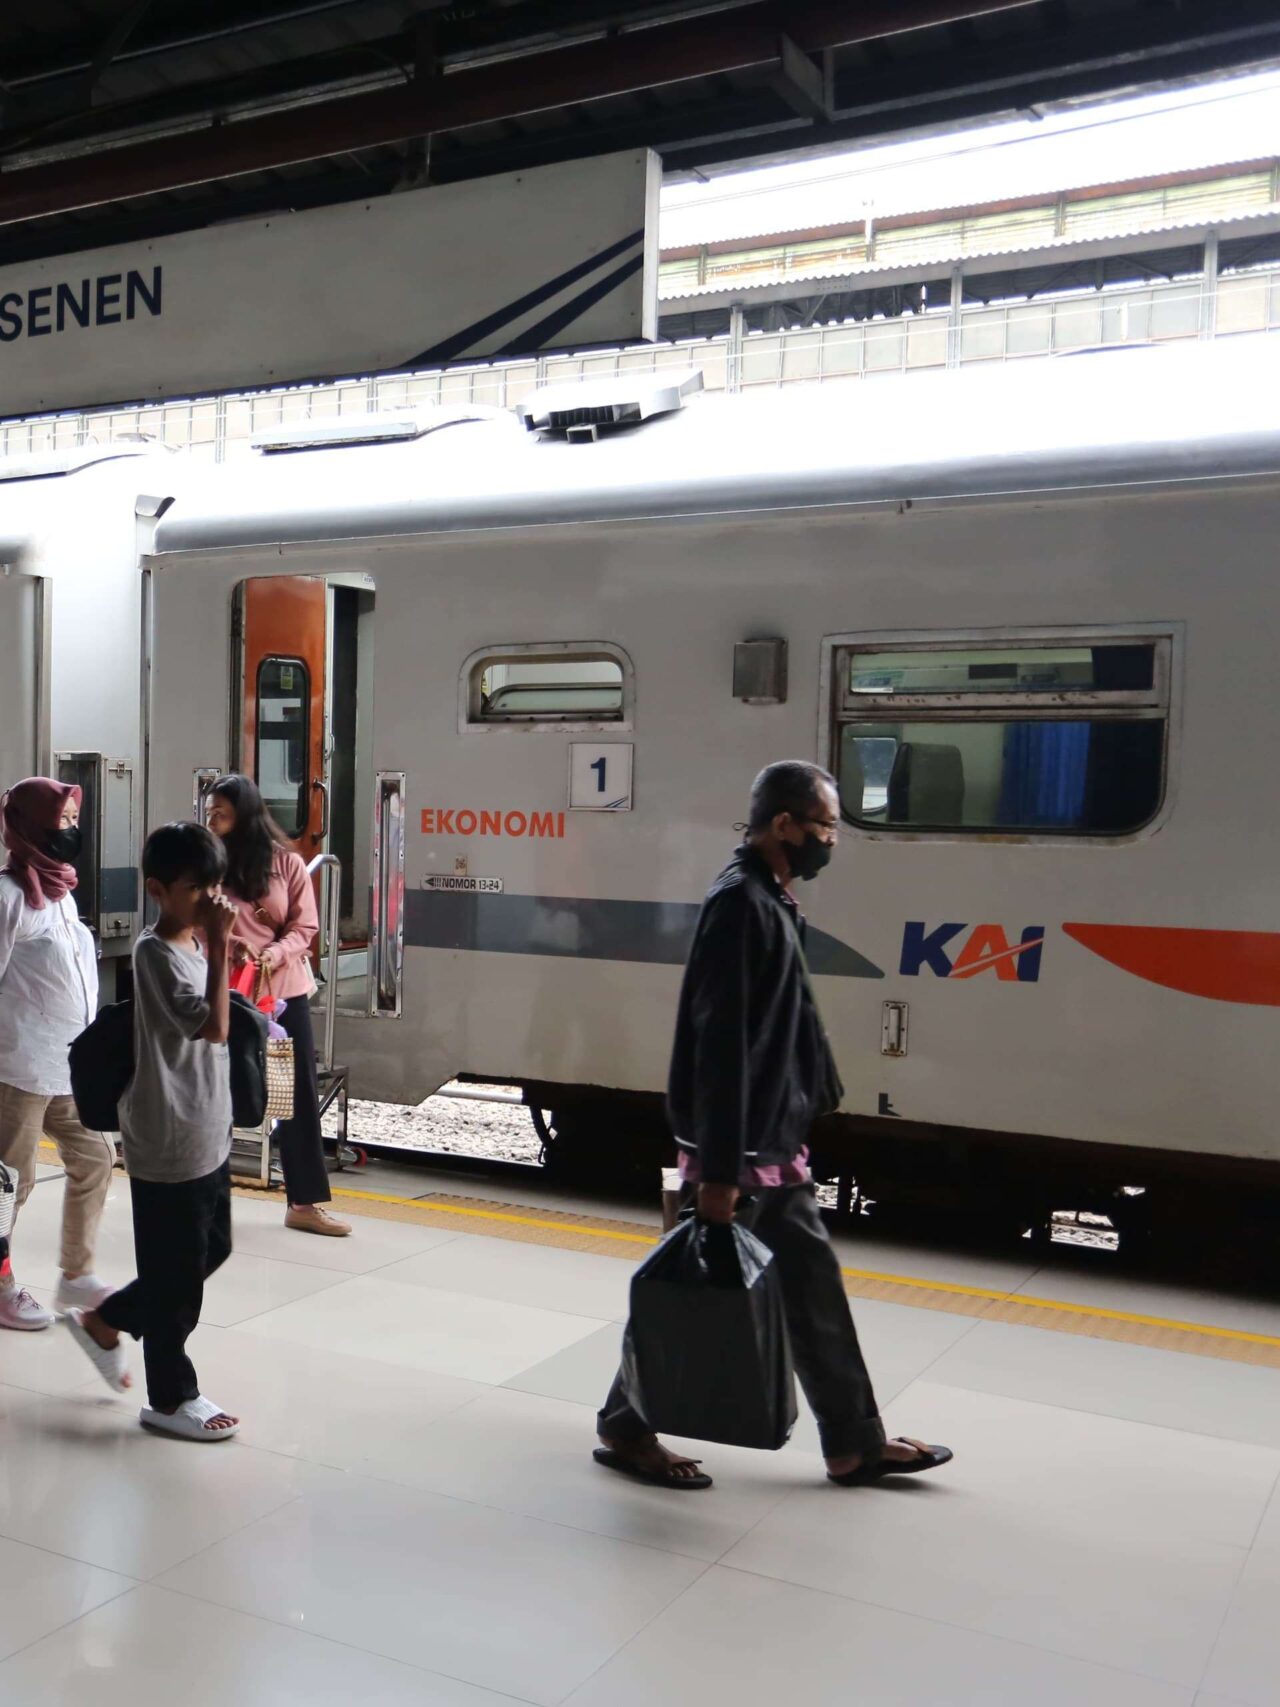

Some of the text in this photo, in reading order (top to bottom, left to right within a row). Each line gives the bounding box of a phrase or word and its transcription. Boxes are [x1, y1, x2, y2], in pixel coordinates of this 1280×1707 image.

[590, 757, 607, 792] 1
[421, 808, 565, 838] EKONOMI
[442, 876, 477, 890] NOMOR
[899, 921, 1045, 982] KAI
